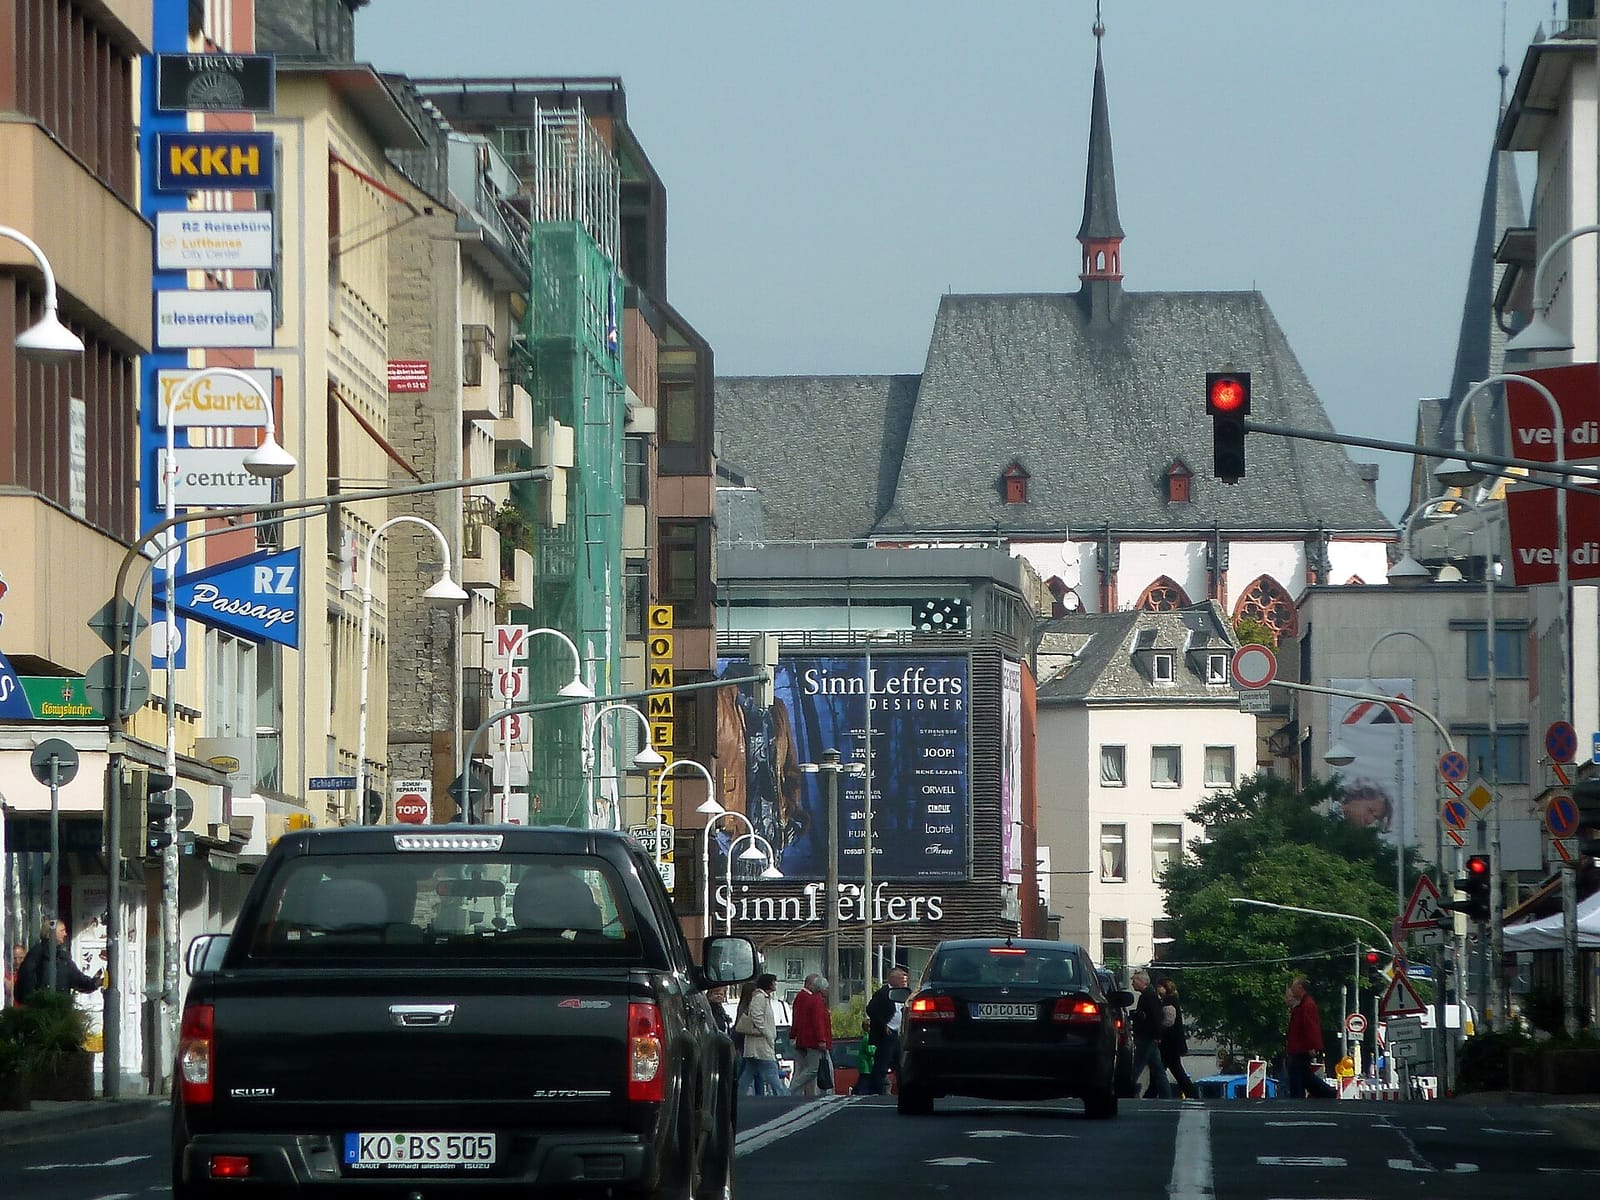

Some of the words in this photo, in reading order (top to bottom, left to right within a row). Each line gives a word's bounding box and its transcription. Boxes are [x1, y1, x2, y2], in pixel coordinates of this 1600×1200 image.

[170, 145, 260, 175] KKH
[205, 220, 271, 232] Reisebüro
[182, 237, 242, 248] Lufthansa
[254, 566, 295, 594] RZ
[189, 583, 294, 628] Passage
[804, 667, 962, 695] SinnLeffers
[41, 701, 93, 717] Königsbacher
[870, 699, 962, 711] DESIGNER
[923, 748, 955, 758] JOOP!
[922, 786, 956, 794] ORWELL
[397, 806, 426, 815] TOPY
[978, 1006, 992, 1016] KO
[231, 1088, 276, 1097] ISUZU
[350, 1150, 356, 1158] D
[360, 1136, 392, 1160] KO
[409, 1136, 441, 1160] BS
[447, 1136, 492, 1160] 505
